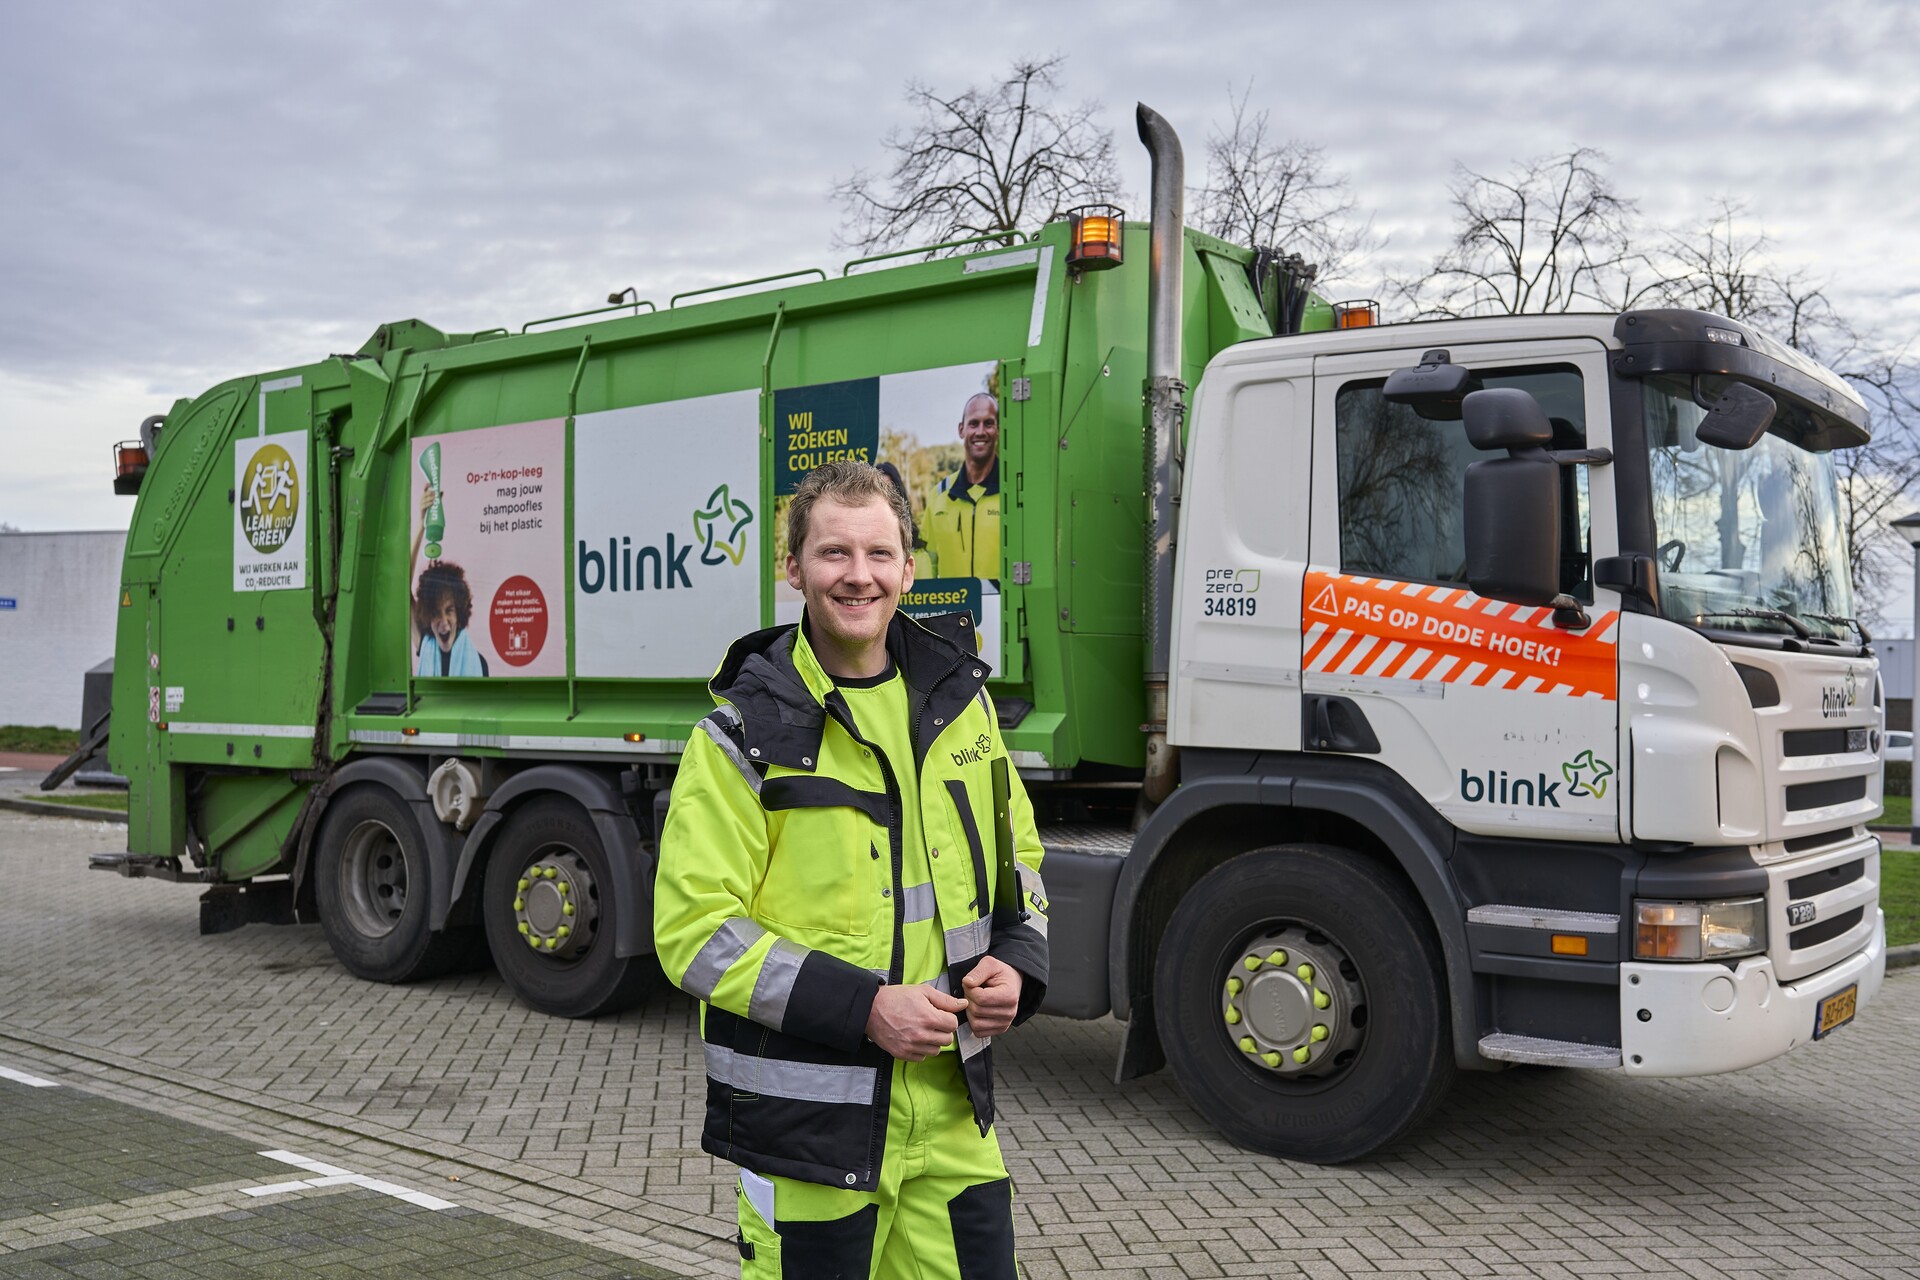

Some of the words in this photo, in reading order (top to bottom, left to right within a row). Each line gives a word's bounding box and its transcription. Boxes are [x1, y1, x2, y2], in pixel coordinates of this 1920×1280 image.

[788, 412, 812, 432] WIJ
[788, 428, 848, 451] ZOEKEN
[788, 447, 868, 471] COLLEGA'S
[466, 466, 543, 484] Op-z'n-kop-leeg
[496, 487, 517, 498] mag
[520, 484, 543, 496] jouw
[483, 500, 543, 516] shampoofles
[246, 514, 273, 532] LEAN
[275, 512, 294, 529] and
[480, 521, 492, 534] bij
[494, 520, 508, 532] het
[512, 518, 542, 532] plastic
[252, 529, 287, 547] GREEN
[240, 564, 251, 574] WIJ
[252, 562, 282, 573] WERKEN
[284, 560, 298, 571] AAN
[578, 532, 693, 594] blink
[1206, 568, 1233, 582] pre
[898, 588, 968, 606] nteresse?
[1206, 582, 1243, 594] zero
[1204, 597, 1256, 617] 34819
[1343, 596, 1385, 622] PAS
[1388, 608, 1420, 630] OP
[1422, 616, 1485, 648] DODE
[1488, 634, 1562, 666] HOEK!
[1822, 687, 1847, 718] blink
[951, 748, 983, 766] blink
[1460, 768, 1560, 808] blink
